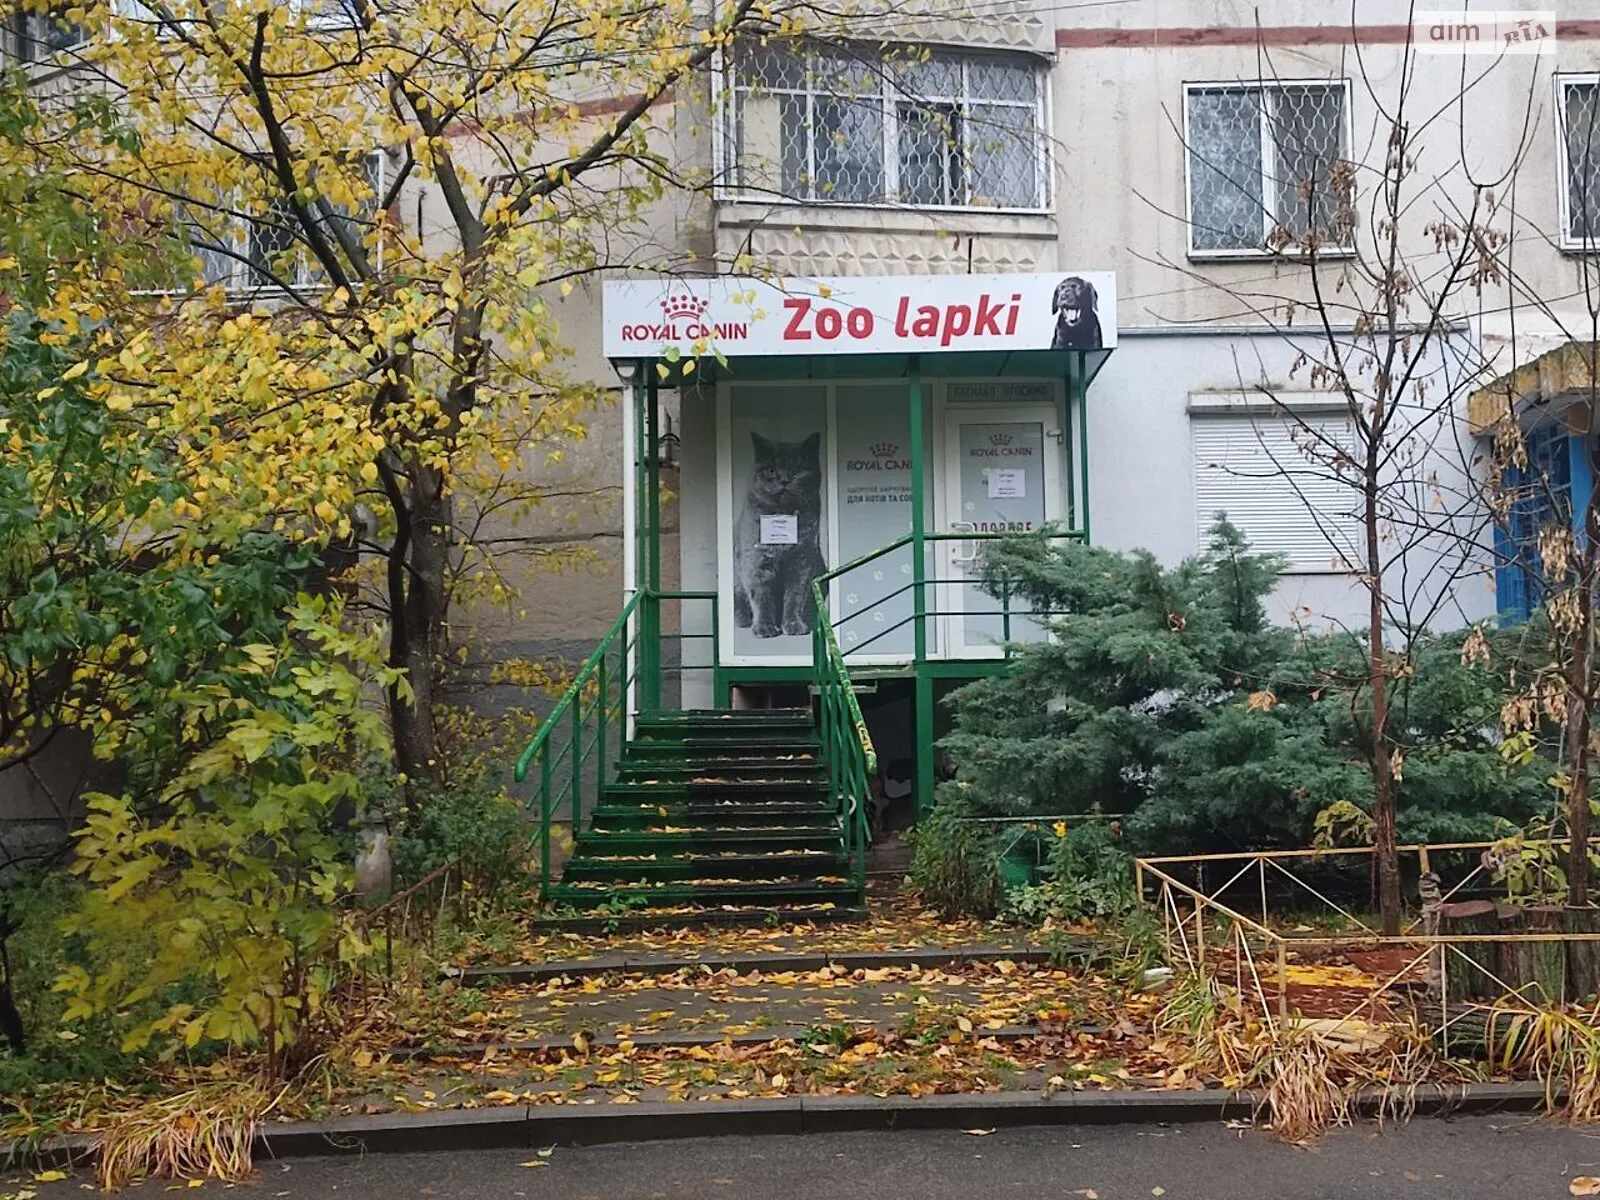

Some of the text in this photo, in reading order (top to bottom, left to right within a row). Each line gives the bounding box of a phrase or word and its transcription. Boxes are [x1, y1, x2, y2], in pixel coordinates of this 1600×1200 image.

[783, 294, 1022, 347] Zoo lapki
[621, 322, 748, 341] ROYAL CANIN
[970, 446, 1033, 457] ROYAL CANIN
[846, 459, 913, 471] ROYAL CANI
[888, 494, 898, 502] ТА
